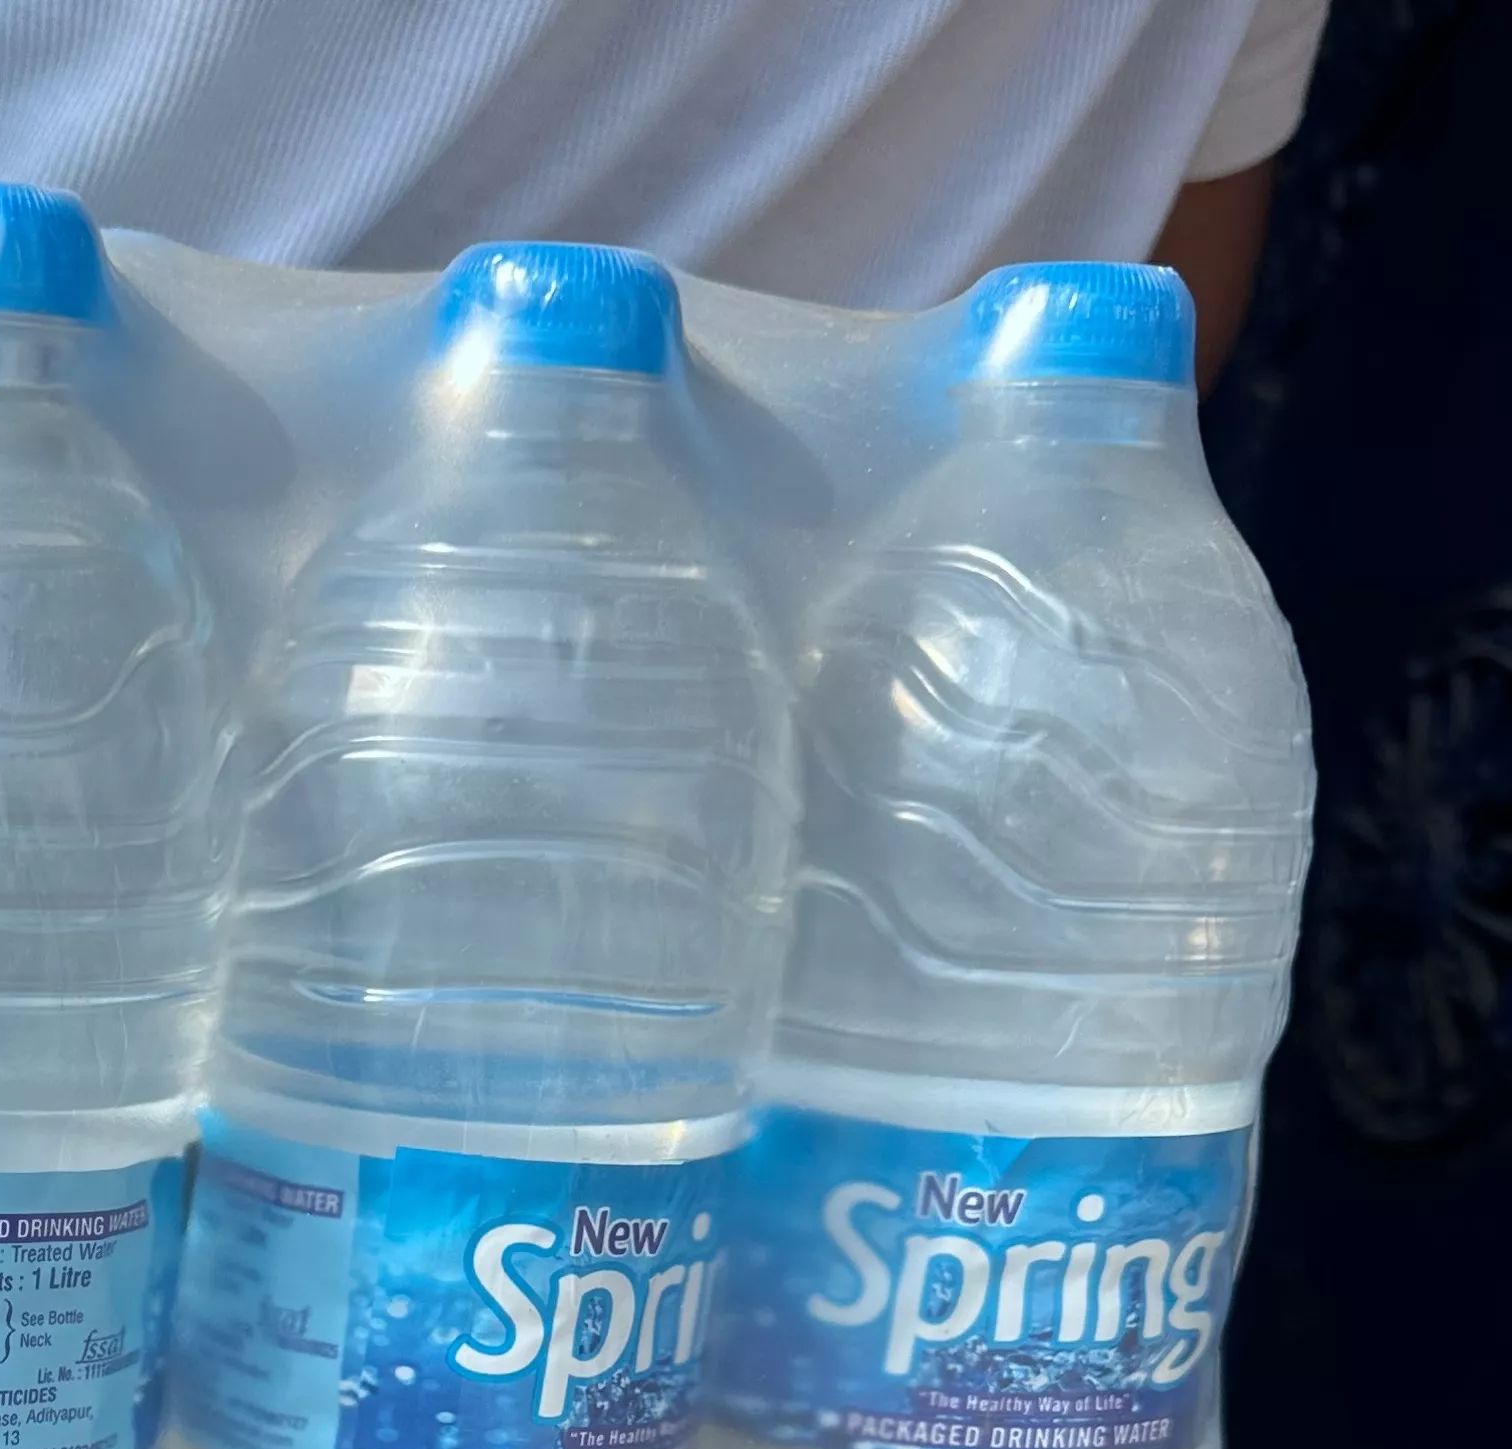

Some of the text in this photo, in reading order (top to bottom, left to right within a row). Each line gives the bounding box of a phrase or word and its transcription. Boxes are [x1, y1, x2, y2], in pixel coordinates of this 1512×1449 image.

[919, 1171, 1026, 1226] New
[17, 1216, 104, 1238] DRINKING
[108, 1206, 147, 1233] WATER
[571, 1207, 670, 1259] New
[11, 1243, 73, 1263] Treated
[79, 1240, 117, 1260] Water
[32, 1269, 40, 1290] 1
[49, 1266, 92, 1289] Litre
[809, 1181, 1225, 1386] Spring
[21, 1309, 84, 1327] See Bottle
[20, 1332, 52, 1348] Neck
[38, 1368, 54, 1384] Lic.
[967, 1391, 1032, 1415] Healthy
[1039, 1392, 1069, 1414] Way
[1075, 1393, 1089, 1411] of
[3, 1431, 20, 1446] 13
[847, 1412, 1171, 1449] PACKAGED DRINKING WATER
